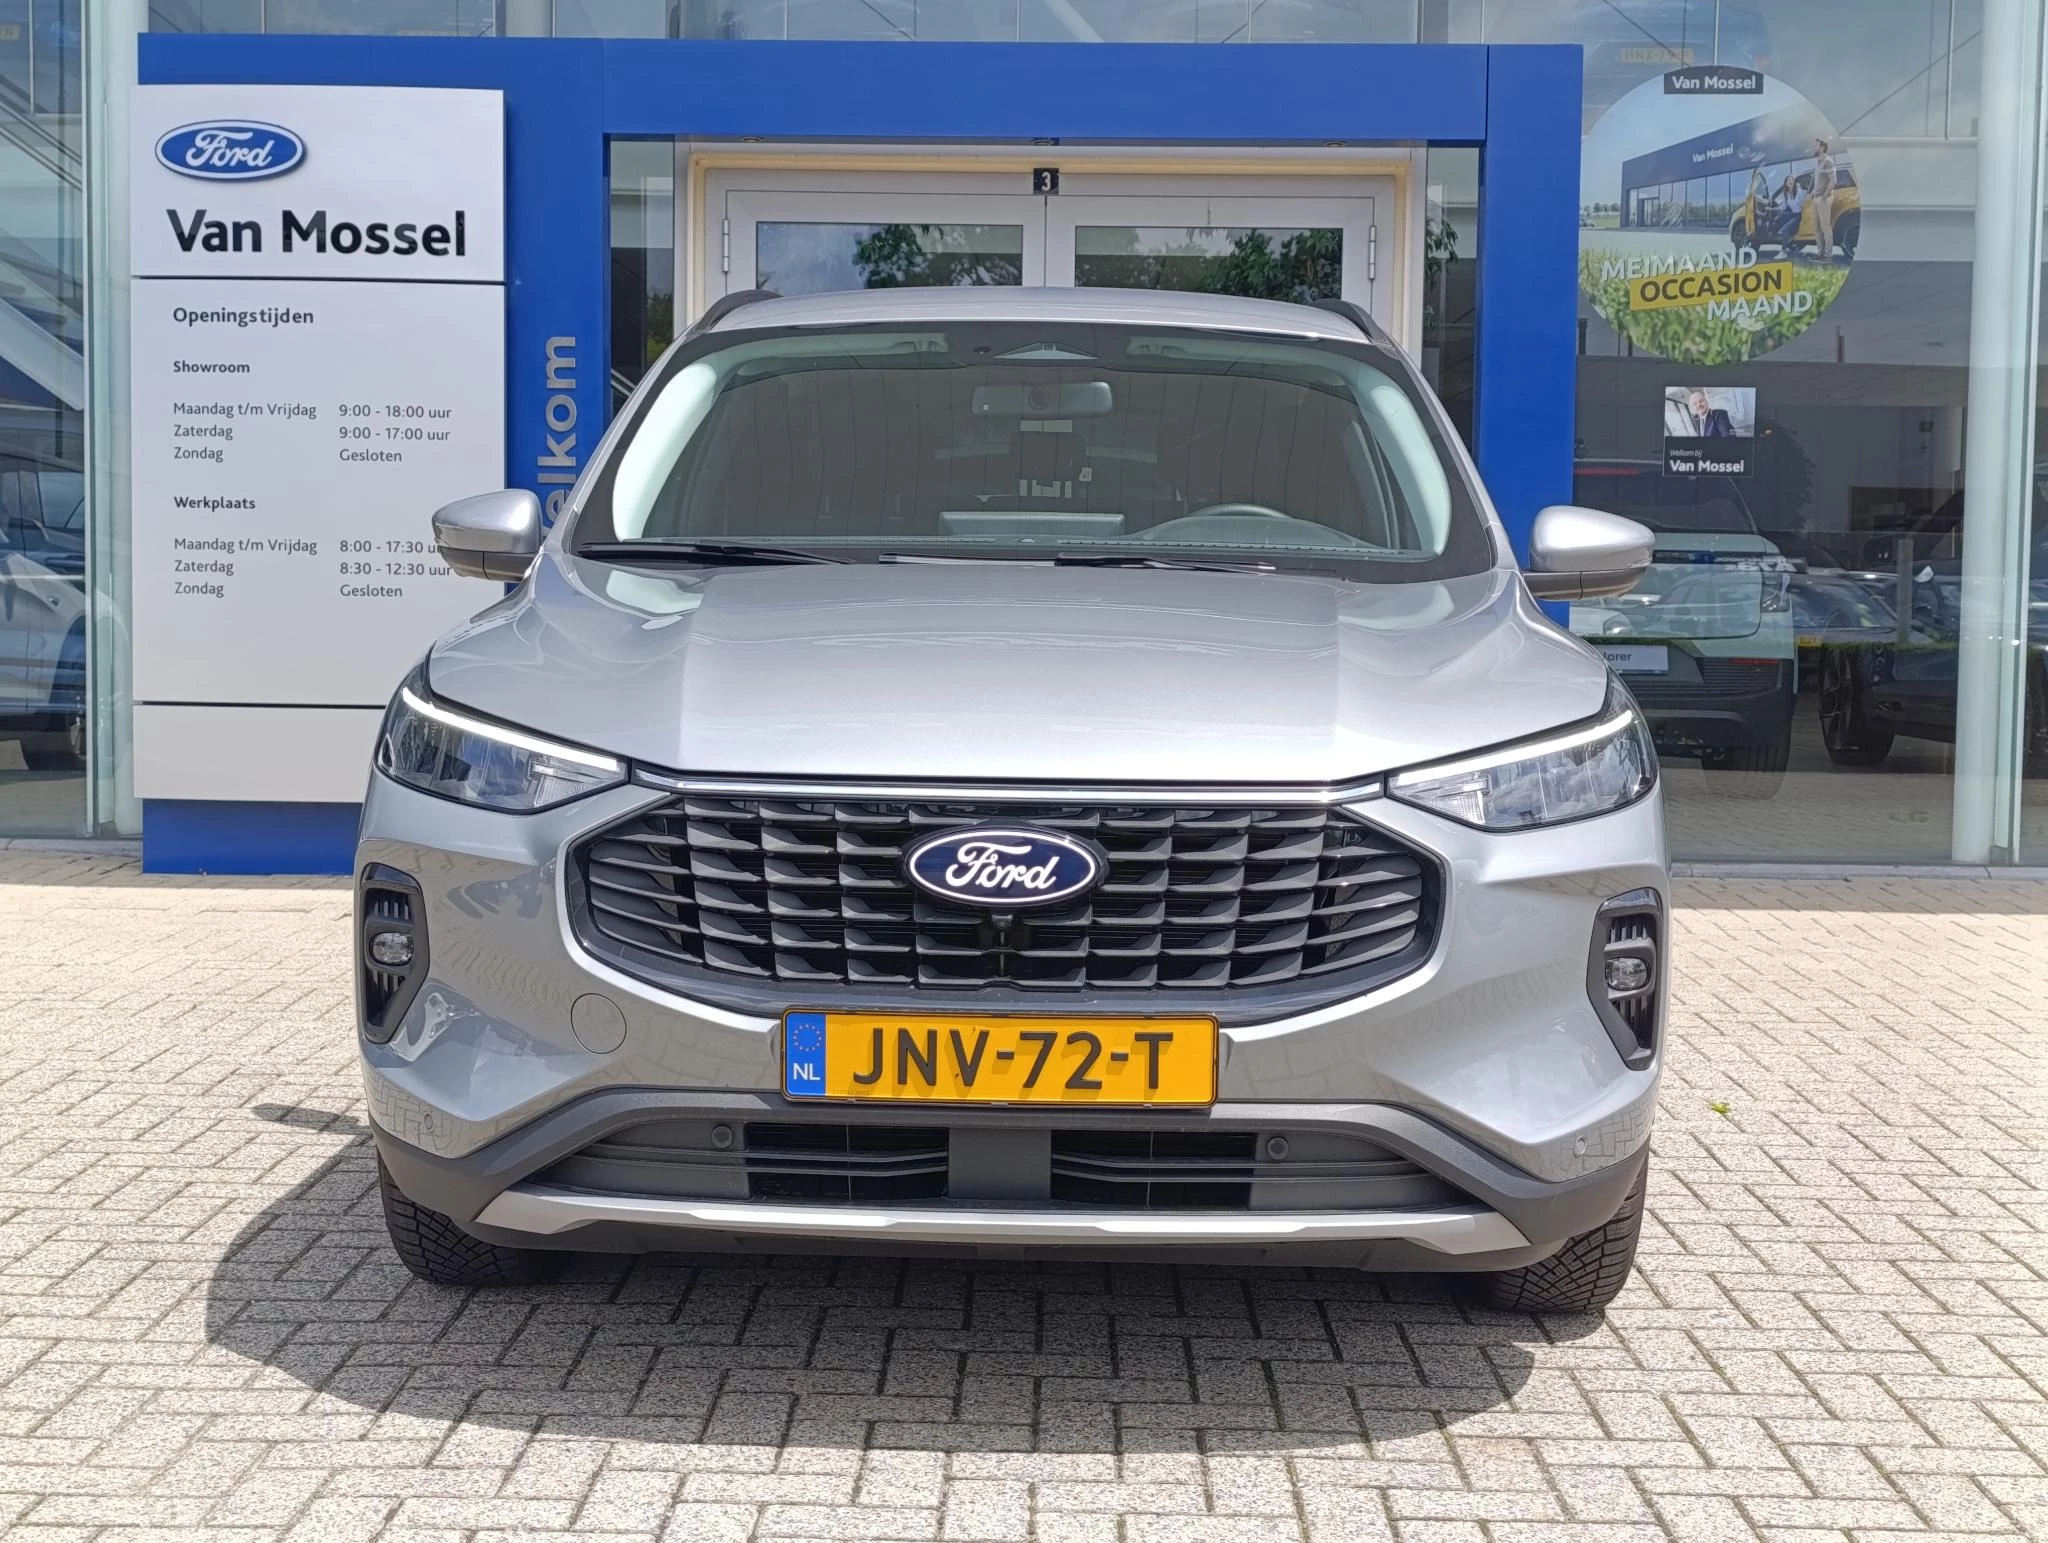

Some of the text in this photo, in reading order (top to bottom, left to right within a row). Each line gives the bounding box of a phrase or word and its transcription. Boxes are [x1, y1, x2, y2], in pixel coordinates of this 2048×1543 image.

[1672, 74, 1756, 89] Van Mossel
[185, 130, 275, 167] Ford
[1692, 143, 1734, 163] Van Mossel
[1042, 171, 1051, 191] 3
[166, 209, 466, 257] Van Mossel
[1602, 247, 1757, 282] MEIMAAND
[1640, 269, 1782, 303] OCCASION
[1707, 290, 1814, 321] MAAND
[173, 307, 314, 328] Openingstijden
[173, 360, 250, 373] Showroom
[173, 402, 317, 420] Maandag t/m Vrijdag
[339, 404, 371, 417] 9:00
[385, 405, 424, 418] 18:00
[428, 409, 452, 418] uur
[173, 424, 233, 441] Zaterdag
[339, 426, 371, 439] 9:00
[385, 427, 423, 440] 17:00
[427, 431, 450, 441] uur
[537, 336, 577, 530] elkom
[173, 446, 224, 463] Zondag
[339, 449, 402, 462] Gesloten
[1670, 449, 1695, 457] Welkom
[1669, 460, 1745, 473] Van Mossel
[173, 496, 256, 512] Werkplaats
[174, 538, 318, 555] Maandag t/m Vrijdag
[340, 540, 372, 553] 8:00
[386, 541, 424, 553] 17:30
[174, 560, 234, 576] Zaterdag
[340, 562, 372, 575] 8:30
[386, 563, 425, 576] 12:30
[429, 567, 451, 576] uur
[174, 582, 224, 599] Zondag
[340, 584, 403, 597] Gesloten
[945, 842, 1060, 889] Ford
[853, 1028, 1174, 1089] JNV-72-T
[792, 1063, 820, 1081] NL
